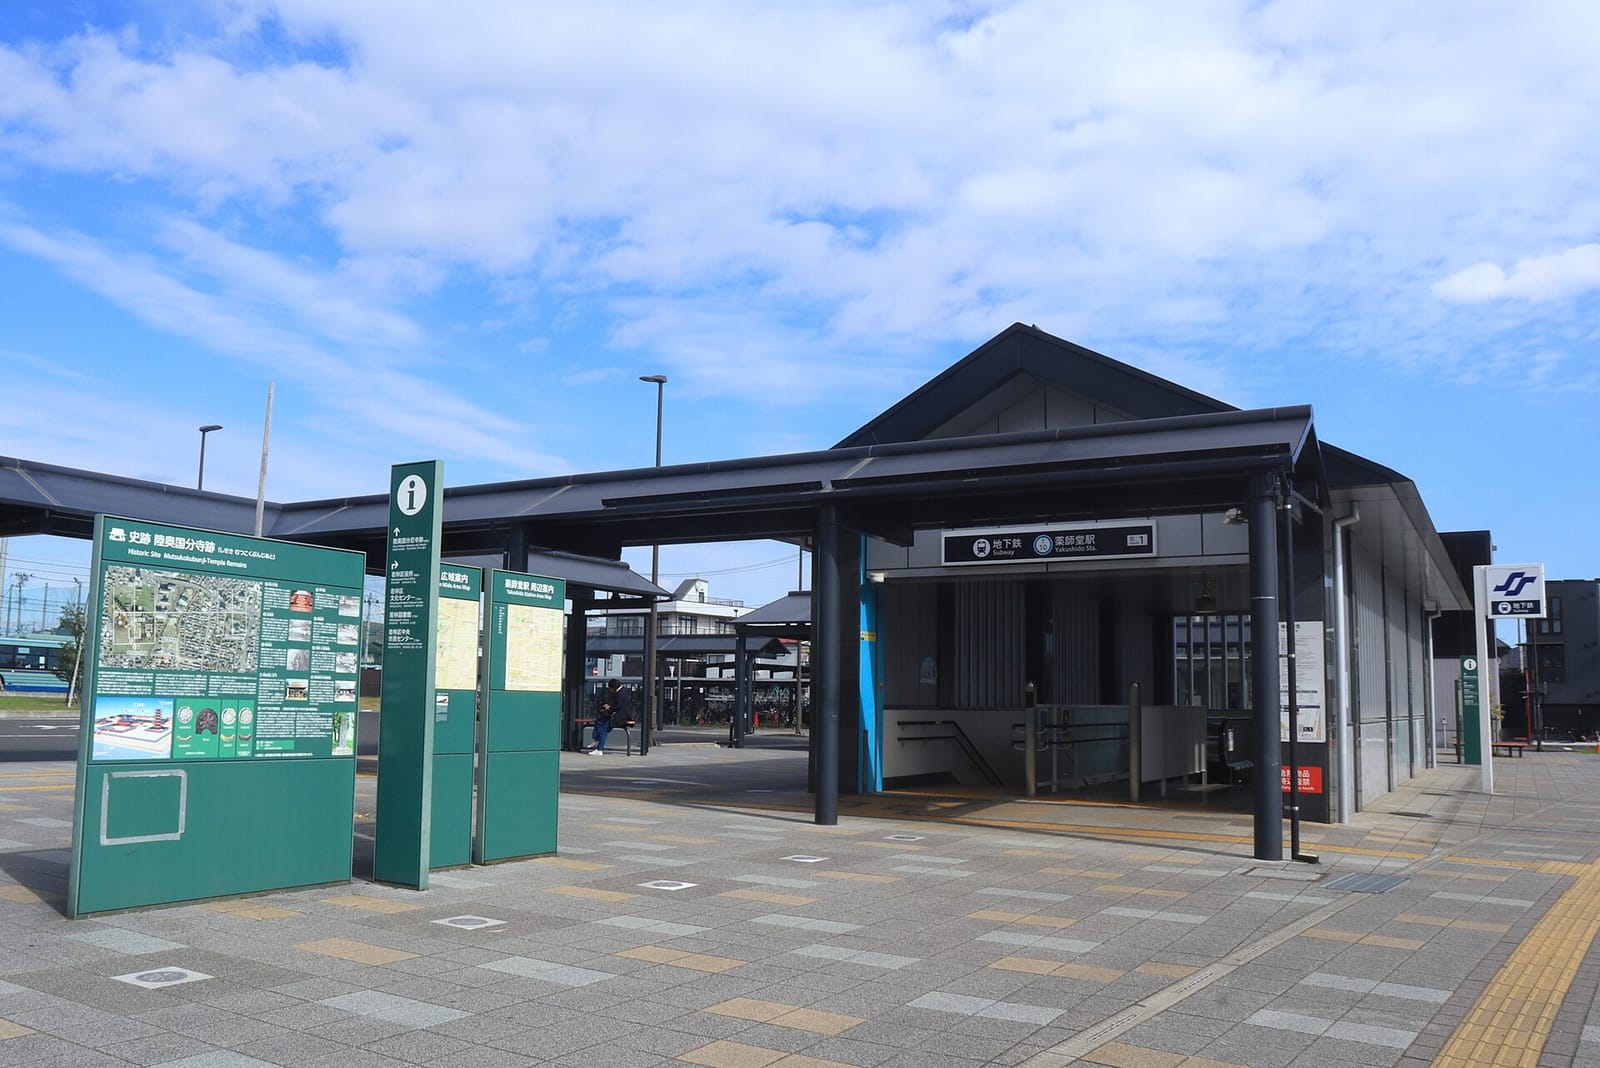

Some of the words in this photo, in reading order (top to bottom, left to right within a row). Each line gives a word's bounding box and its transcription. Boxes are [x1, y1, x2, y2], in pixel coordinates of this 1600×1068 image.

[128, 530, 151, 545] 史跡
[154, 534, 216, 553] 陸奥国分寺跡
[992, 538, 1022, 549] 地下鉄
[1055, 534, 1096, 546] 薬師堂駅
[128, 548, 150, 557] Historic
[226, 560, 248, 568] Remains
[440, 572, 468, 584] 広域案内
